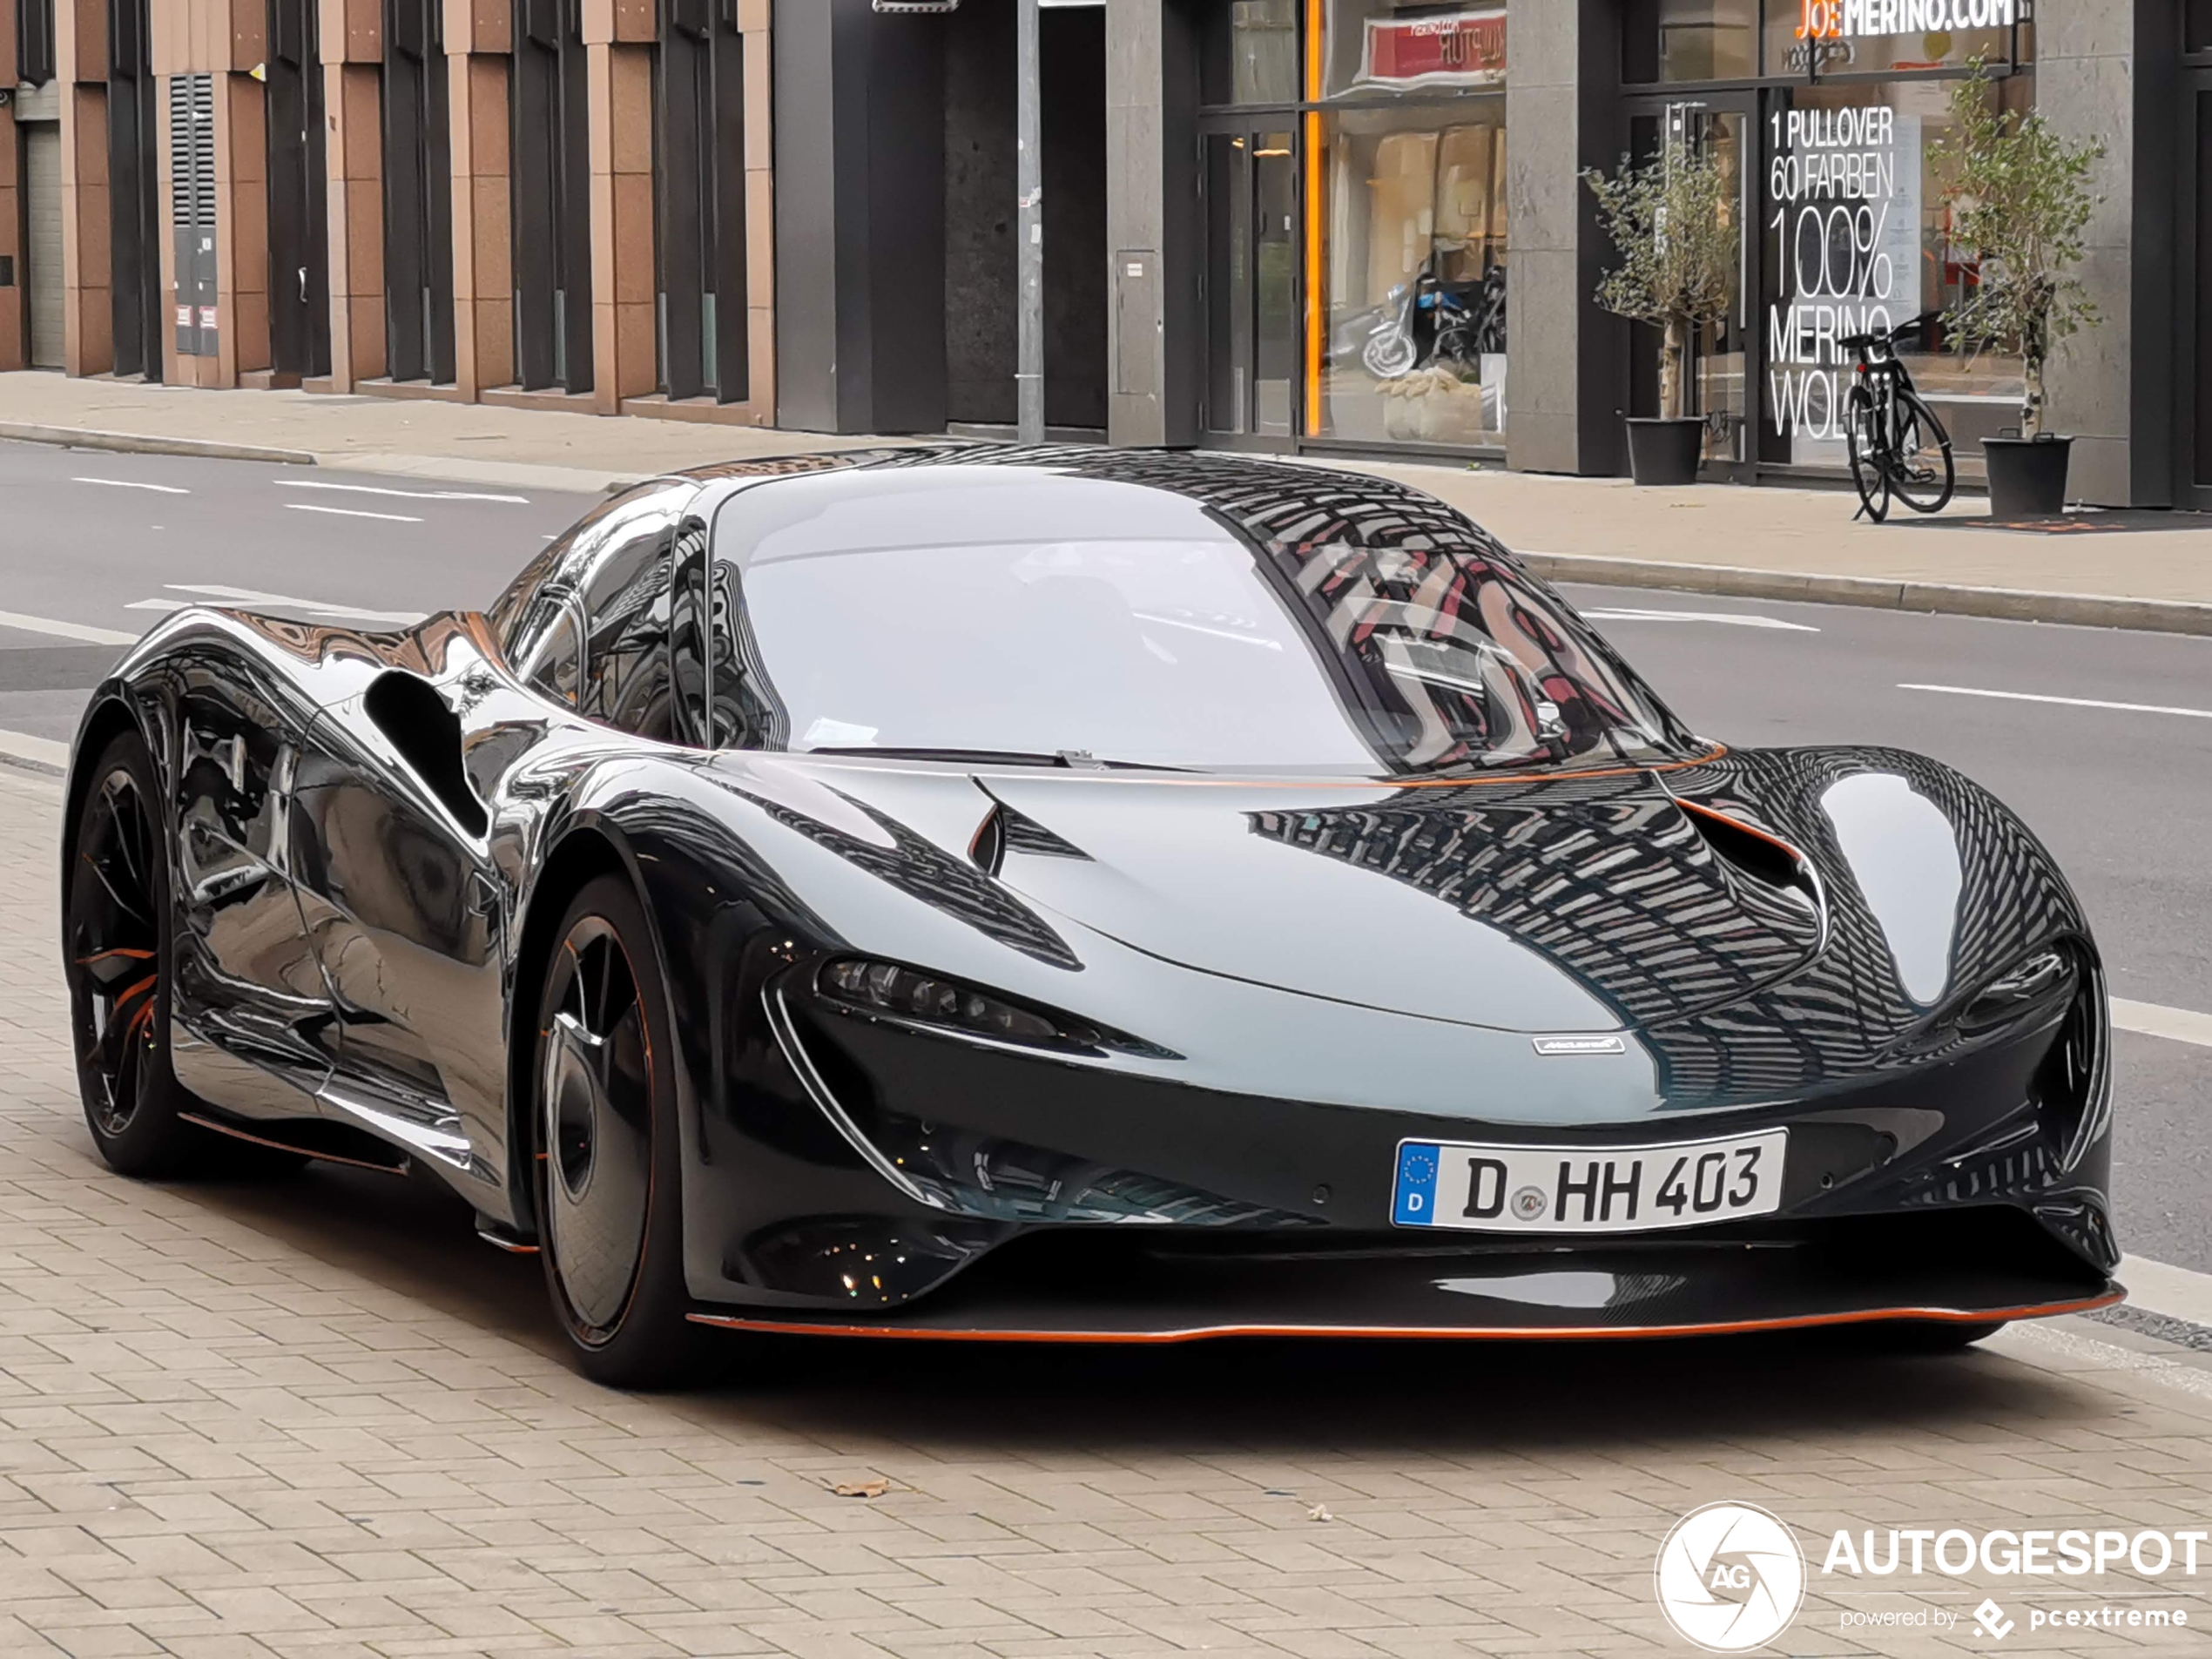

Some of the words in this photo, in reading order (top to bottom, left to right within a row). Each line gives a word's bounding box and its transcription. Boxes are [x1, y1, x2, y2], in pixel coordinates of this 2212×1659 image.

[1795, 0, 2014, 39] JOEMERINO.COM
[1770, 111, 1779, 149] 1
[1787, 106, 1892, 148] PULLOVER
[1770, 155, 1799, 200] 60
[1804, 152, 1893, 200] FARBEN
[1770, 201, 1892, 302] 100%
[1770, 304, 1892, 366] MERINO
[1407, 1193, 1423, 1212] D
[1463, 1157, 1507, 1218] D
[1554, 1160, 1642, 1222] HH
[1656, 1146, 1762, 1216] 403
